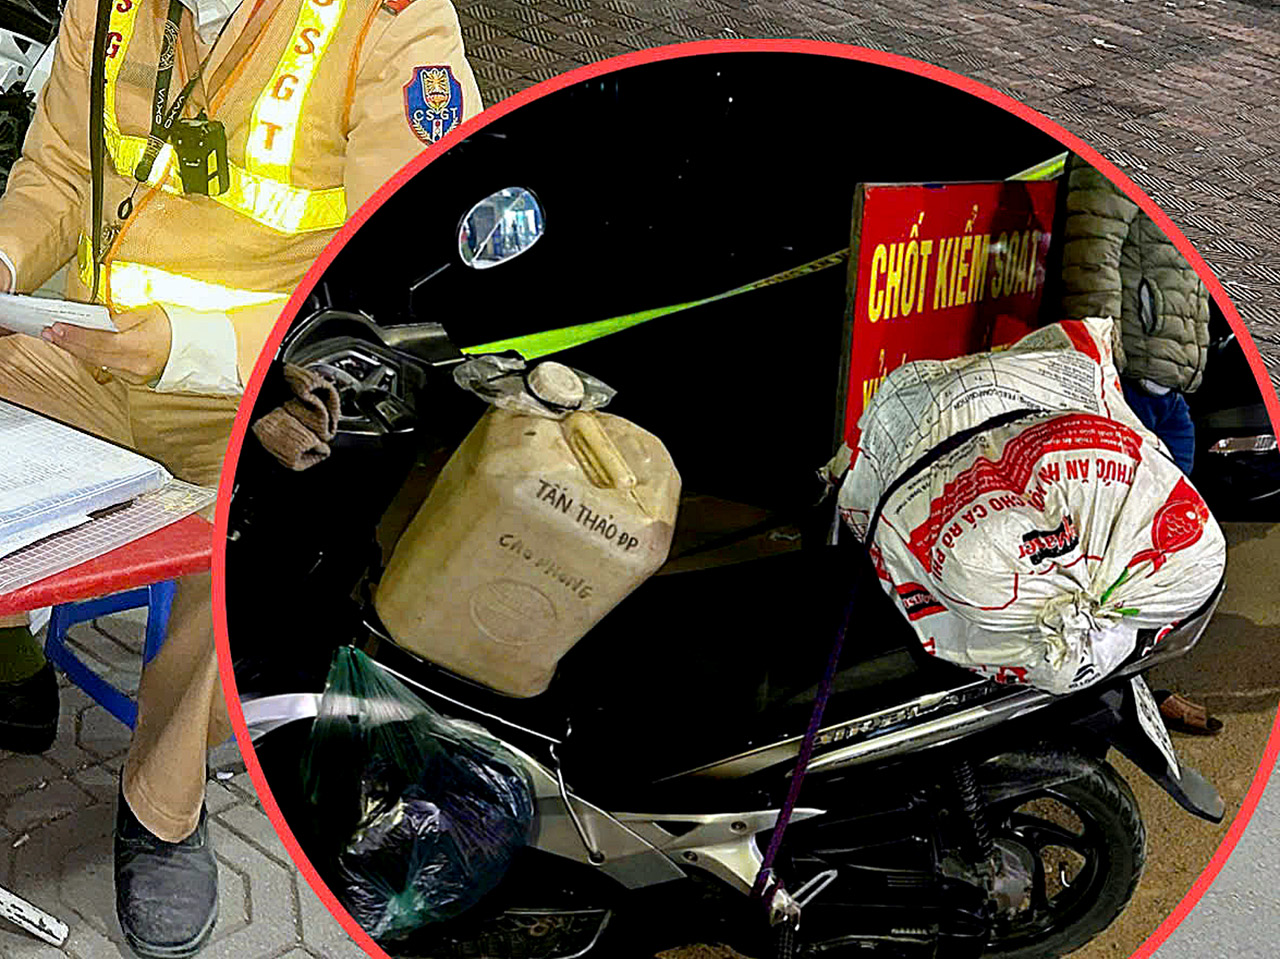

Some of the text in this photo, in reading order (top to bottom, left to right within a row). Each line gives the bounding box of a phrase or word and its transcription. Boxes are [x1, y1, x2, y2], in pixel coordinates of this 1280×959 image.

[155, 88, 167, 125] VAXO
[868, 211, 932, 323] CHỐT
[933, 205, 990, 311] KIỂM
[1066, 458, 1091, 484] ĂN
[1096, 458, 1133, 487] THỨC
[536, 479, 574, 514] TẤN
[575, 504, 618, 541] THẢO
[988, 490, 1023, 511] CHO
[963, 501, 987, 532] CÁ
[939, 521, 964, 553] RÔ
